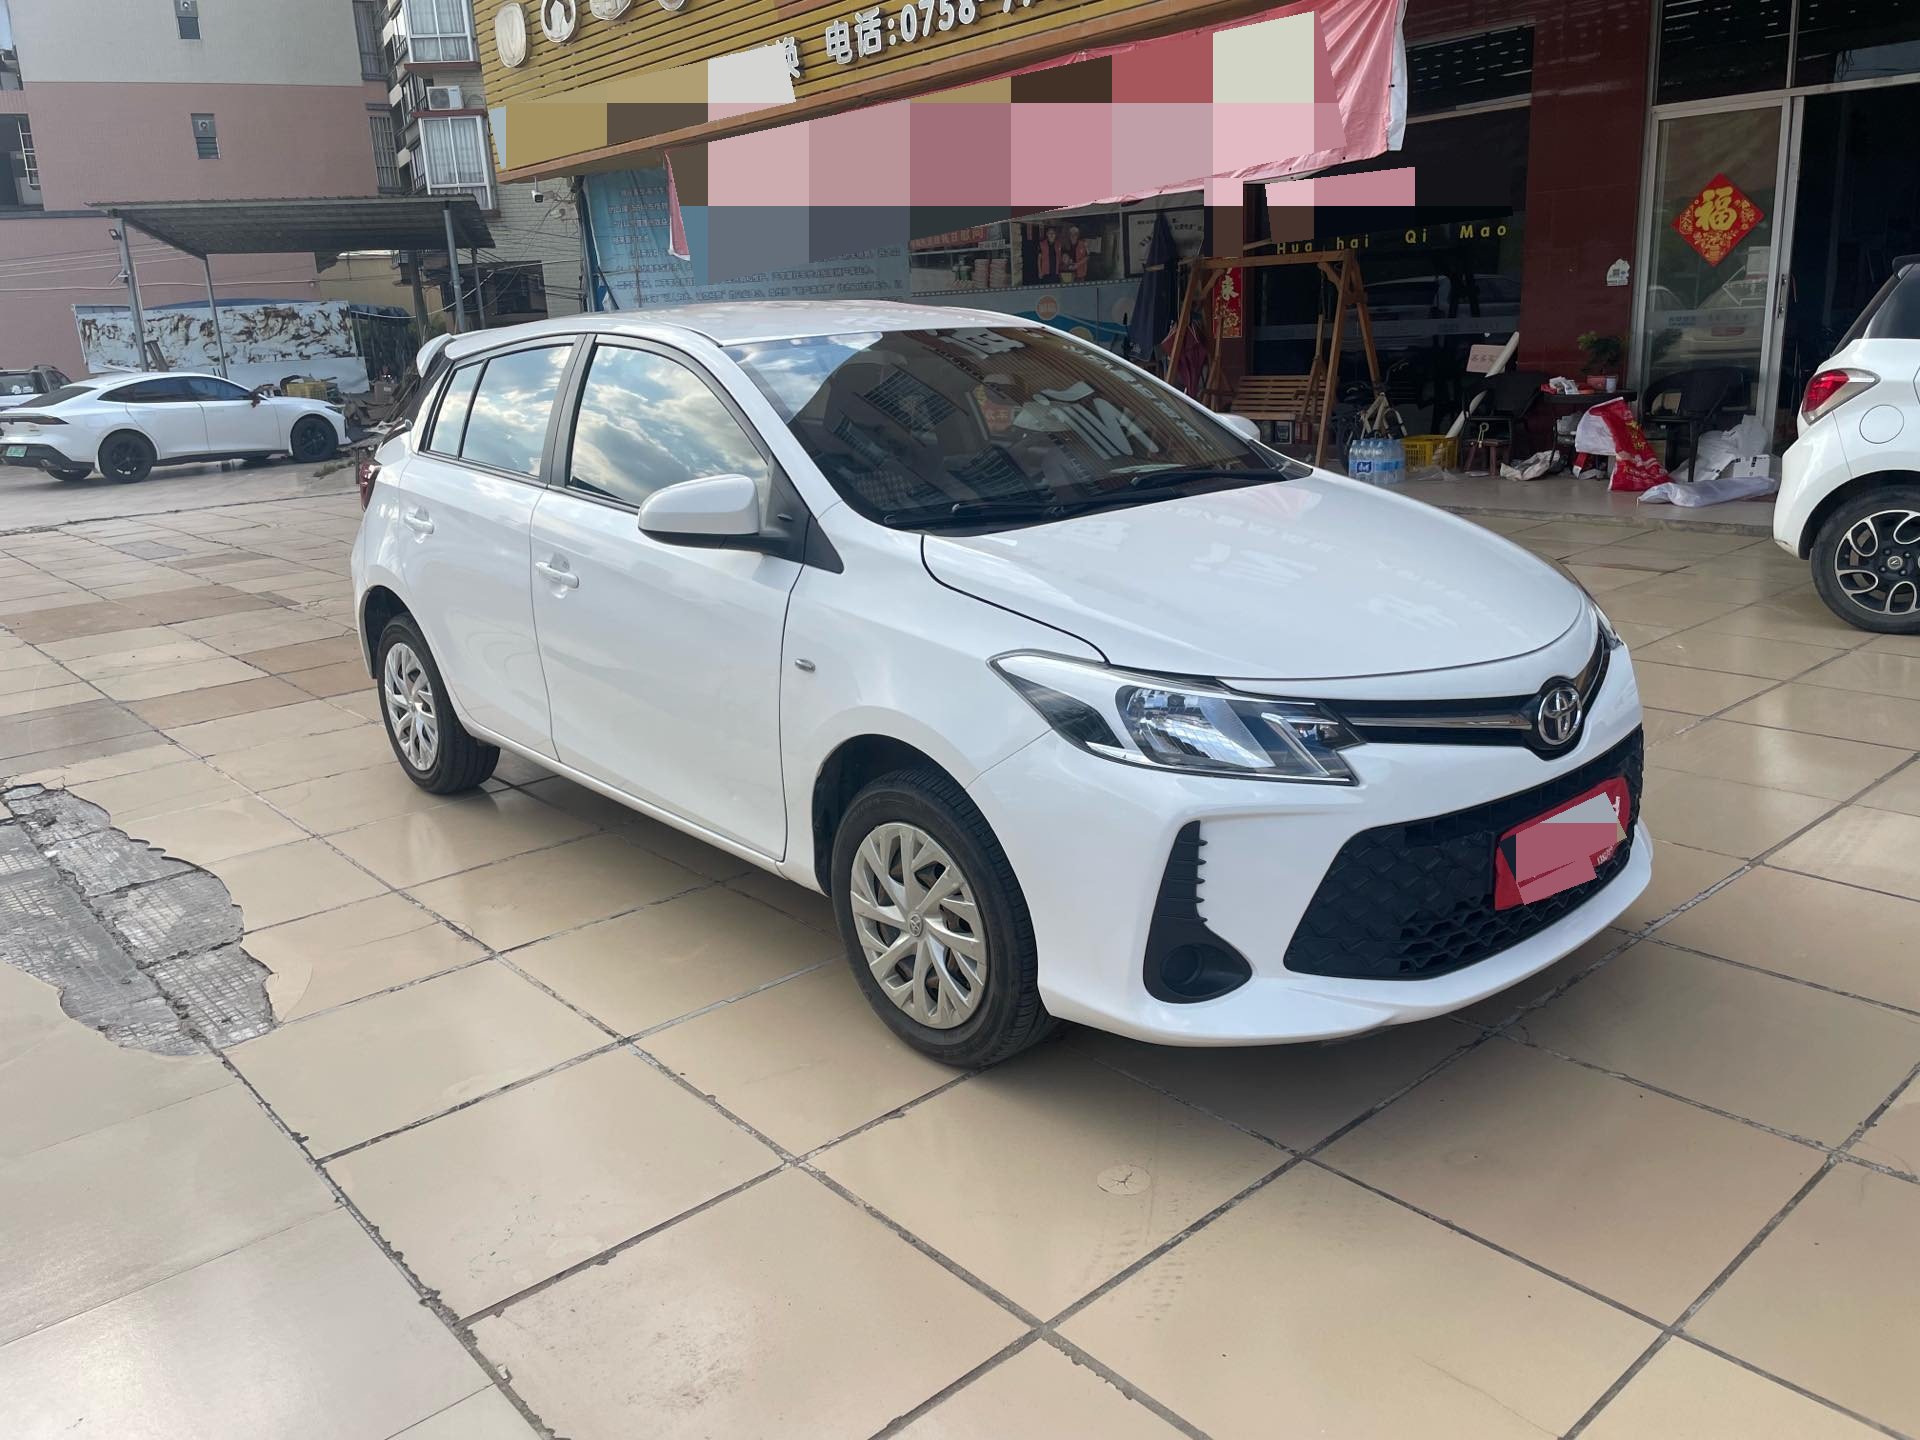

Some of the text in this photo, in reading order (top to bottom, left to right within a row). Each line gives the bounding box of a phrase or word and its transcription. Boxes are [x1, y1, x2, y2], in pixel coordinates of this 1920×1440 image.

[825, 0, 1032, 65] 电话:0758
[1694, 185, 1739, 232] 福
[1276, 224, 1507, 255] Hua hai Qi Mao
